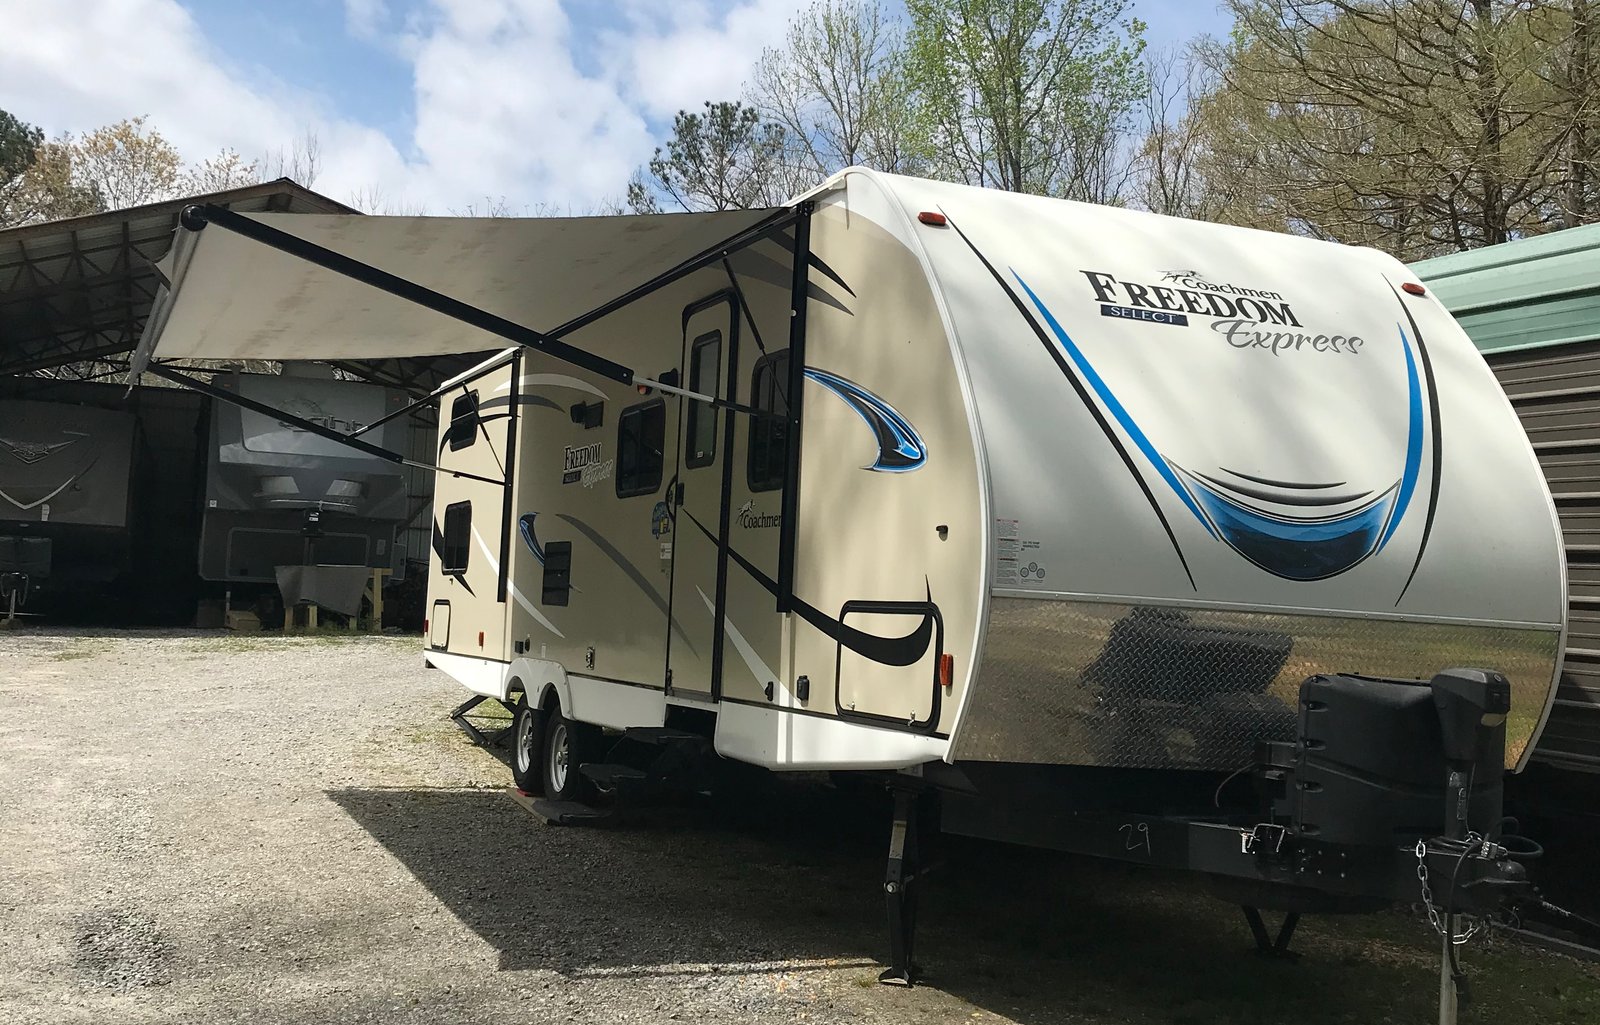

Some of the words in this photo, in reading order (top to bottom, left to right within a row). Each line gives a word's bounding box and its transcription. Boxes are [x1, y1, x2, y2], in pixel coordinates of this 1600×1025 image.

[1079, 270, 1304, 328] FREEDOM
[1182, 278, 1283, 300] Coachmen
[1111, 307, 1176, 323] SELECT
[1211, 319, 1364, 357] Express
[563, 443, 602, 471] FREEDOM
[1119, 822, 1151, 857] 29
